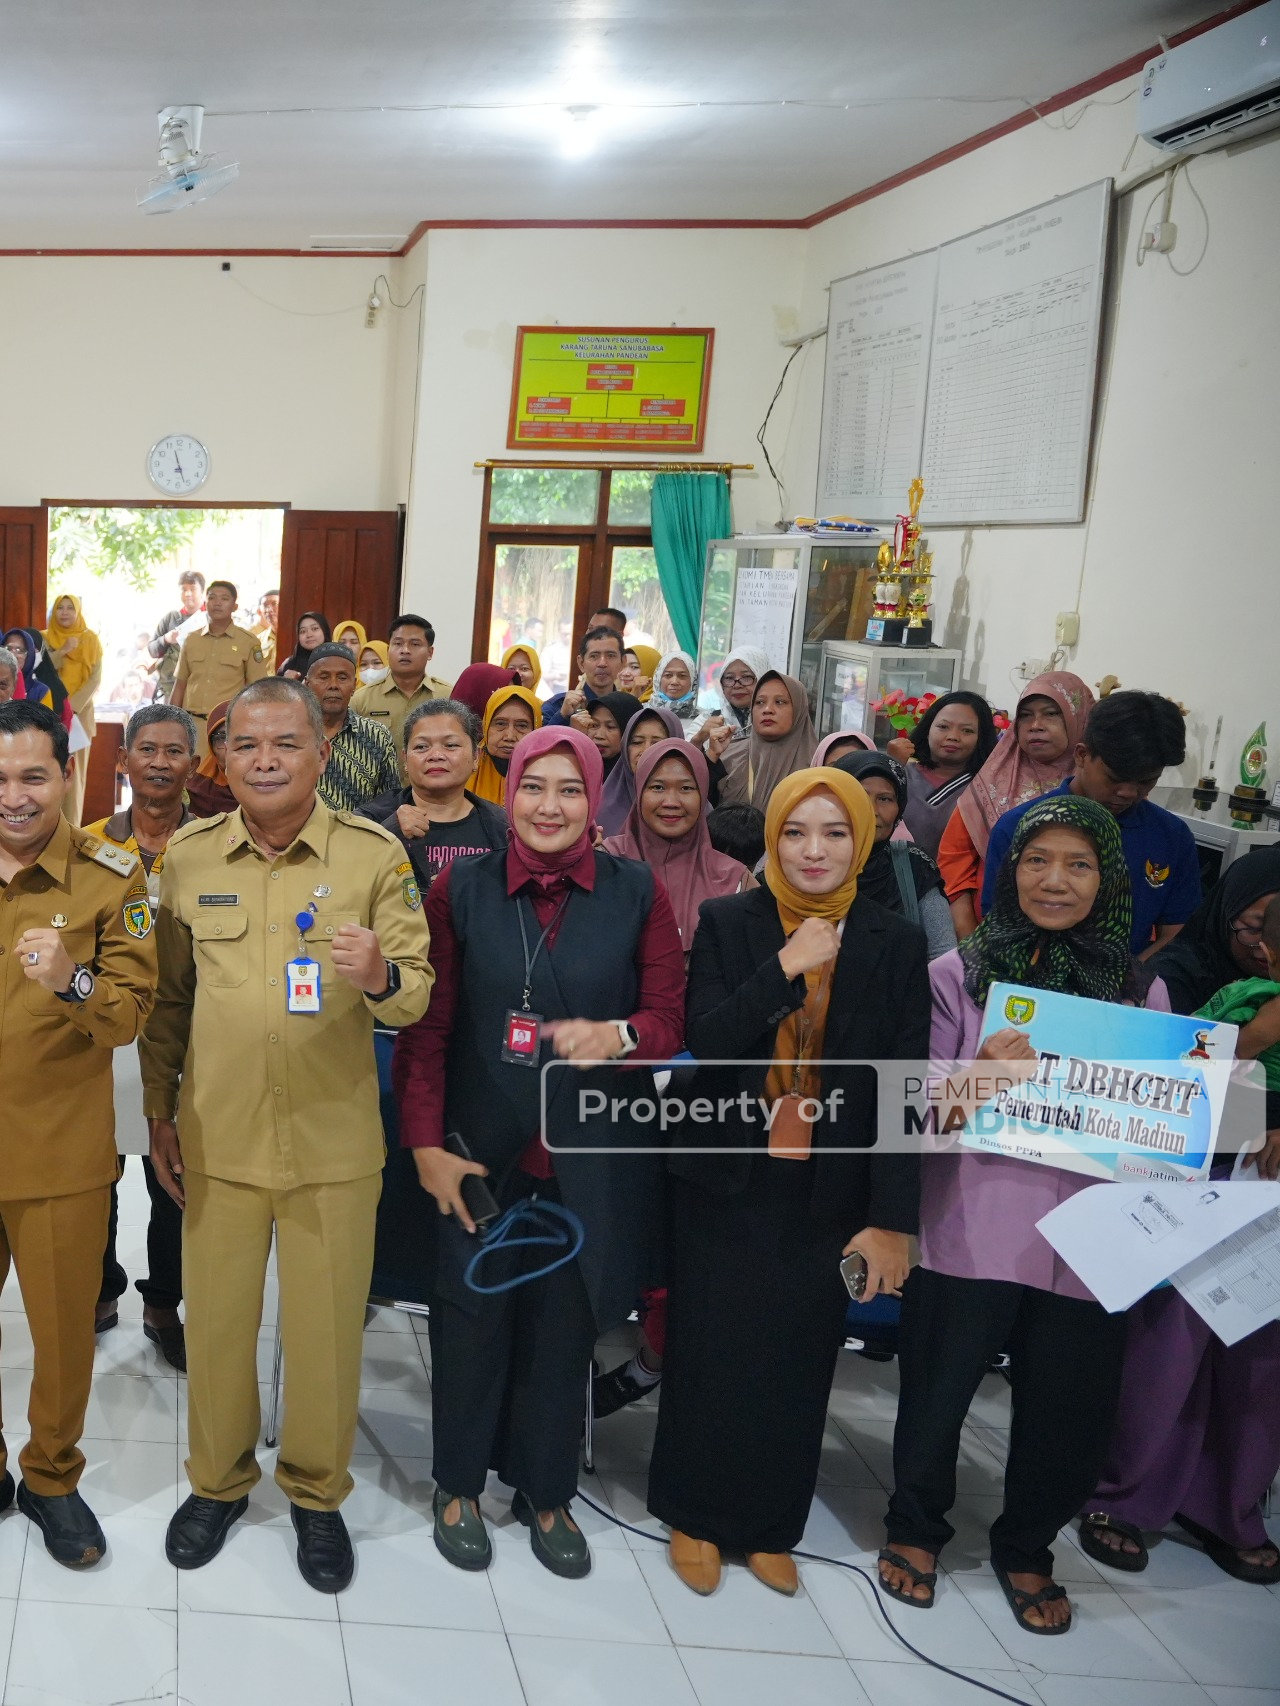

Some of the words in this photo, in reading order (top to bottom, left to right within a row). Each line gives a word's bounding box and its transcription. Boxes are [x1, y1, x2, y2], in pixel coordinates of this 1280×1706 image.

[1063, 1057, 1200, 1117] DBHCHT
[993, 1089, 1082, 1131] Pemerintah
[1083, 1107, 1122, 1141] Kota
[1123, 1119, 1186, 1155] Madiun
[978, 1137, 1013, 1152] Dinsos
[1015, 1144, 1043, 1159] PPPA
[1122, 1162, 1179, 1183] bankjatim
